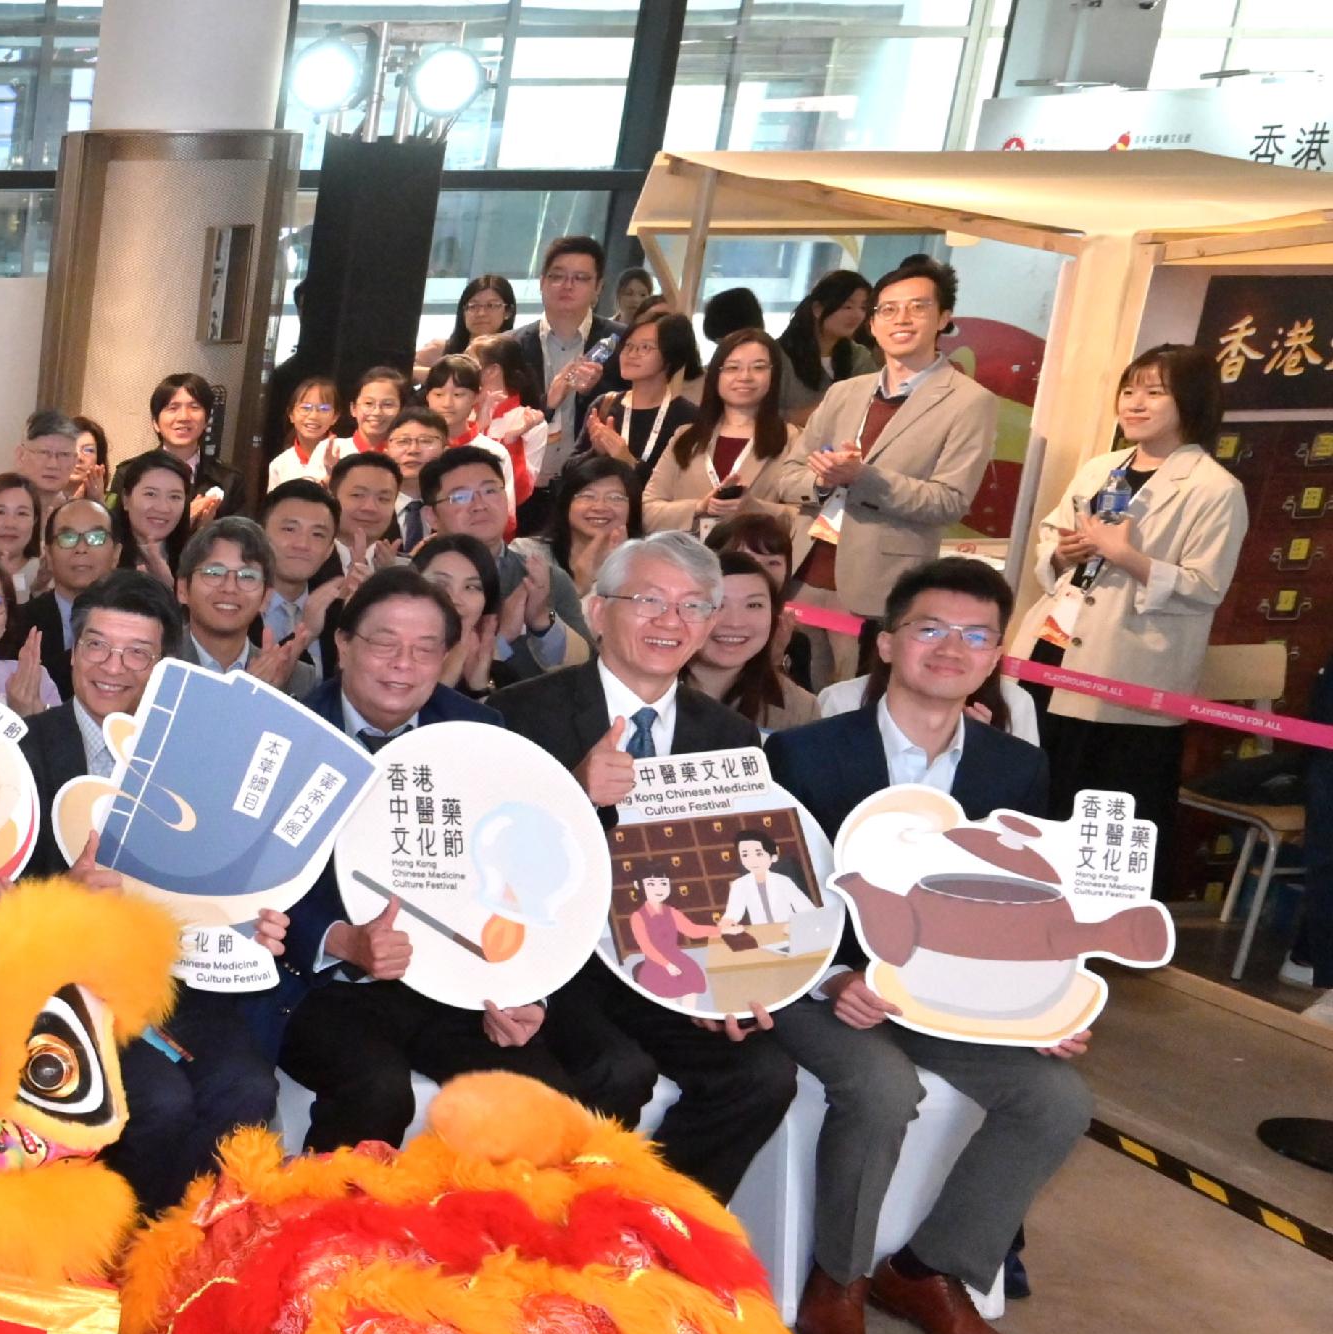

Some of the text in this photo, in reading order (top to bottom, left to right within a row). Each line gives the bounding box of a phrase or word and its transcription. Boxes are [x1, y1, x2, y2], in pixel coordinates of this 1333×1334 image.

[1215, 314, 1333, 384] 香港
[387, 762, 434, 793] 香港
[639, 755, 760, 787] 中醫藥文化節
[634, 790, 664, 803] Kong
[665, 787, 711, 800] Chinese
[713, 780, 765, 794] Medicine
[389, 795, 463, 827] 中醫藥
[644, 799, 731, 816] Culture Festival
[1081, 795, 1126, 821] 香港
[390, 827, 464, 858] 文化節
[1080, 822, 1150, 849] 中醫藥
[391, 859, 438, 870] Hong Kong
[1076, 845, 1148, 874] 文化節
[392, 869, 466, 880] Chinese Medicine
[392, 880, 458, 890] Culture Festival
[1074, 879, 1145, 892] Chinese Medicine
[1075, 870, 1120, 882] Hong Kong
[179, 930, 233, 954] 化節
[213, 959, 259, 970] Medicine
[196, 970, 271, 984] Culture Festival
